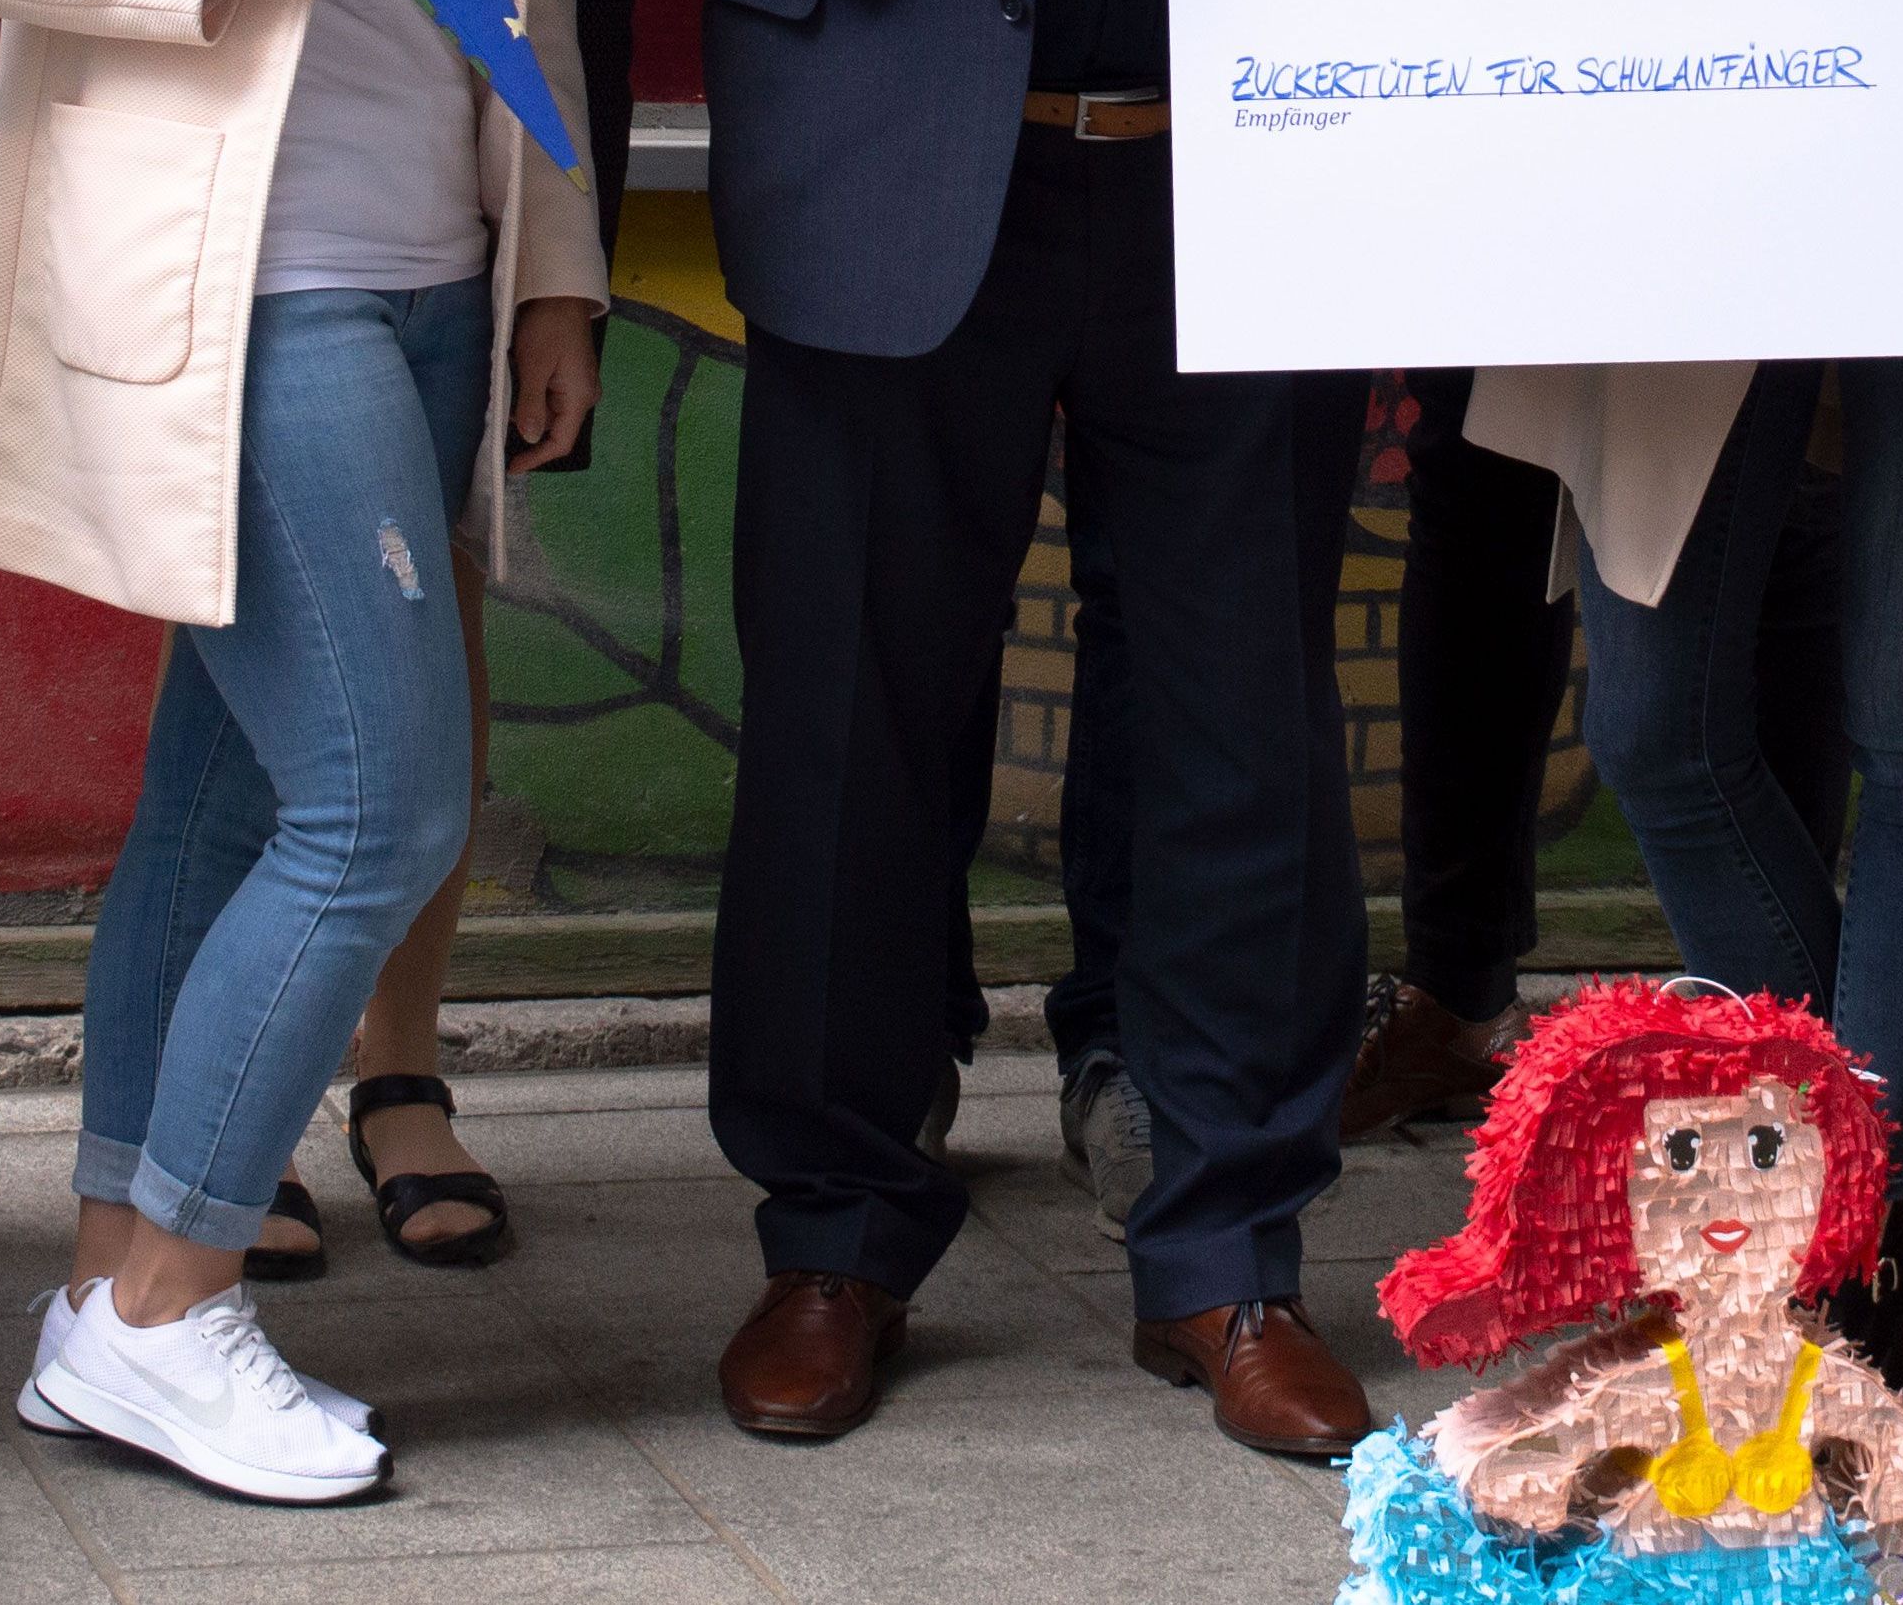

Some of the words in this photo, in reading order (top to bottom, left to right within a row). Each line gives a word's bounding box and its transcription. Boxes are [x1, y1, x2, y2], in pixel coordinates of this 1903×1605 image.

[1231, 56, 1473, 101] ZUCKERTÜTEN
[1486, 54, 1565, 96] FÜR
[1577, 43, 1871, 95] SCHULANFÄNGER
[1234, 106, 1352, 131] Empfänger
